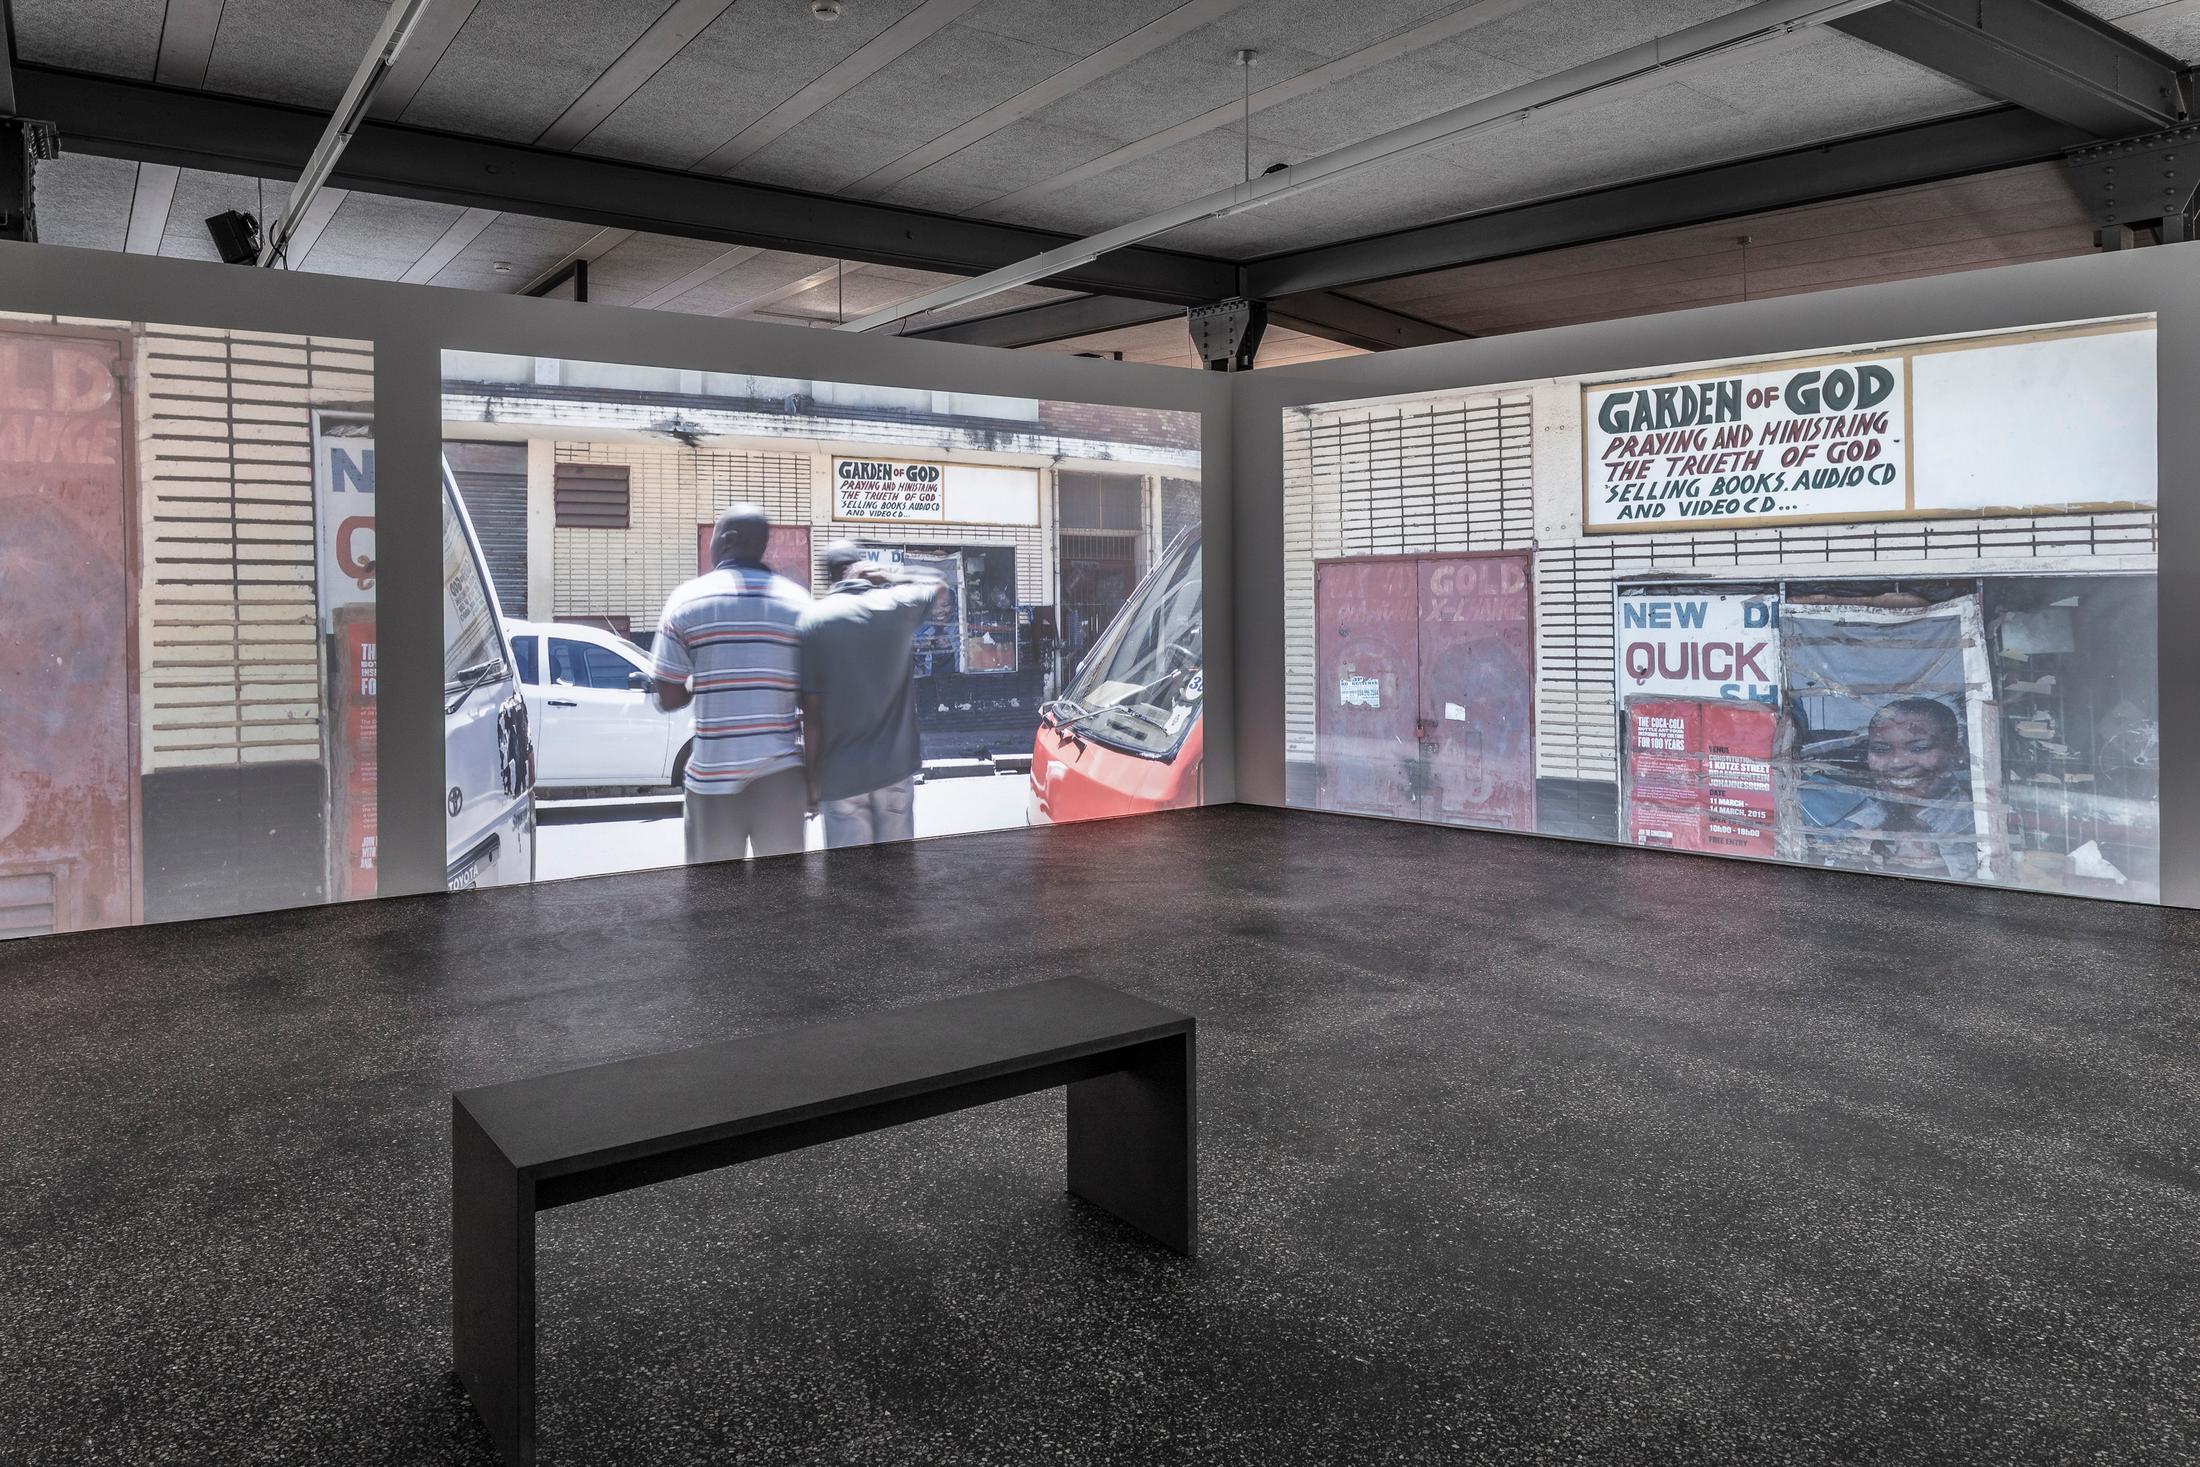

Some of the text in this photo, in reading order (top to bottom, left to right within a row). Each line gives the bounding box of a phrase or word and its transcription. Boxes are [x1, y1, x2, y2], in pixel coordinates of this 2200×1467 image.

[1597, 365, 1895, 434] GARDEN OF GOD
[1601, 411, 1890, 460] PRAYING AND MINISTRING
[1605, 438, 1882, 482] THE TRUETH OF GOD
[838, 461, 940, 482] GARDEN OF GOD
[840, 480, 938, 493] PRAYING AND MINISTRING
[1605, 478, 1701, 503] SELLING
[841, 491, 936, 501] THE TRUETH OF GOD
[841, 500, 878, 510] SELLING
[1617, 503, 1666, 520] AND
[846, 509, 865, 517] AND
[1624, 601, 1708, 629] NEW
[1626, 641, 1770, 686] QUICK
[1638, 716, 1684, 729] THE COCA-COLA
[1638, 737, 1685, 751] FOR 100 YEARS
[1709, 760, 1713, 769] 1
[1714, 761, 1740, 771] KOTZE
[1740, 763, 1770, 773] STREET
[1709, 789, 1726, 797] DATE
[1710, 797, 1718, 805] 11
[1719, 798, 1744, 807] MARCH
[1710, 805, 1718, 813] 14
[1747, 810, 1767, 819] 2015
[1710, 824, 1732, 834] 10h00
[449, 864, 479, 891] TOYOTA
